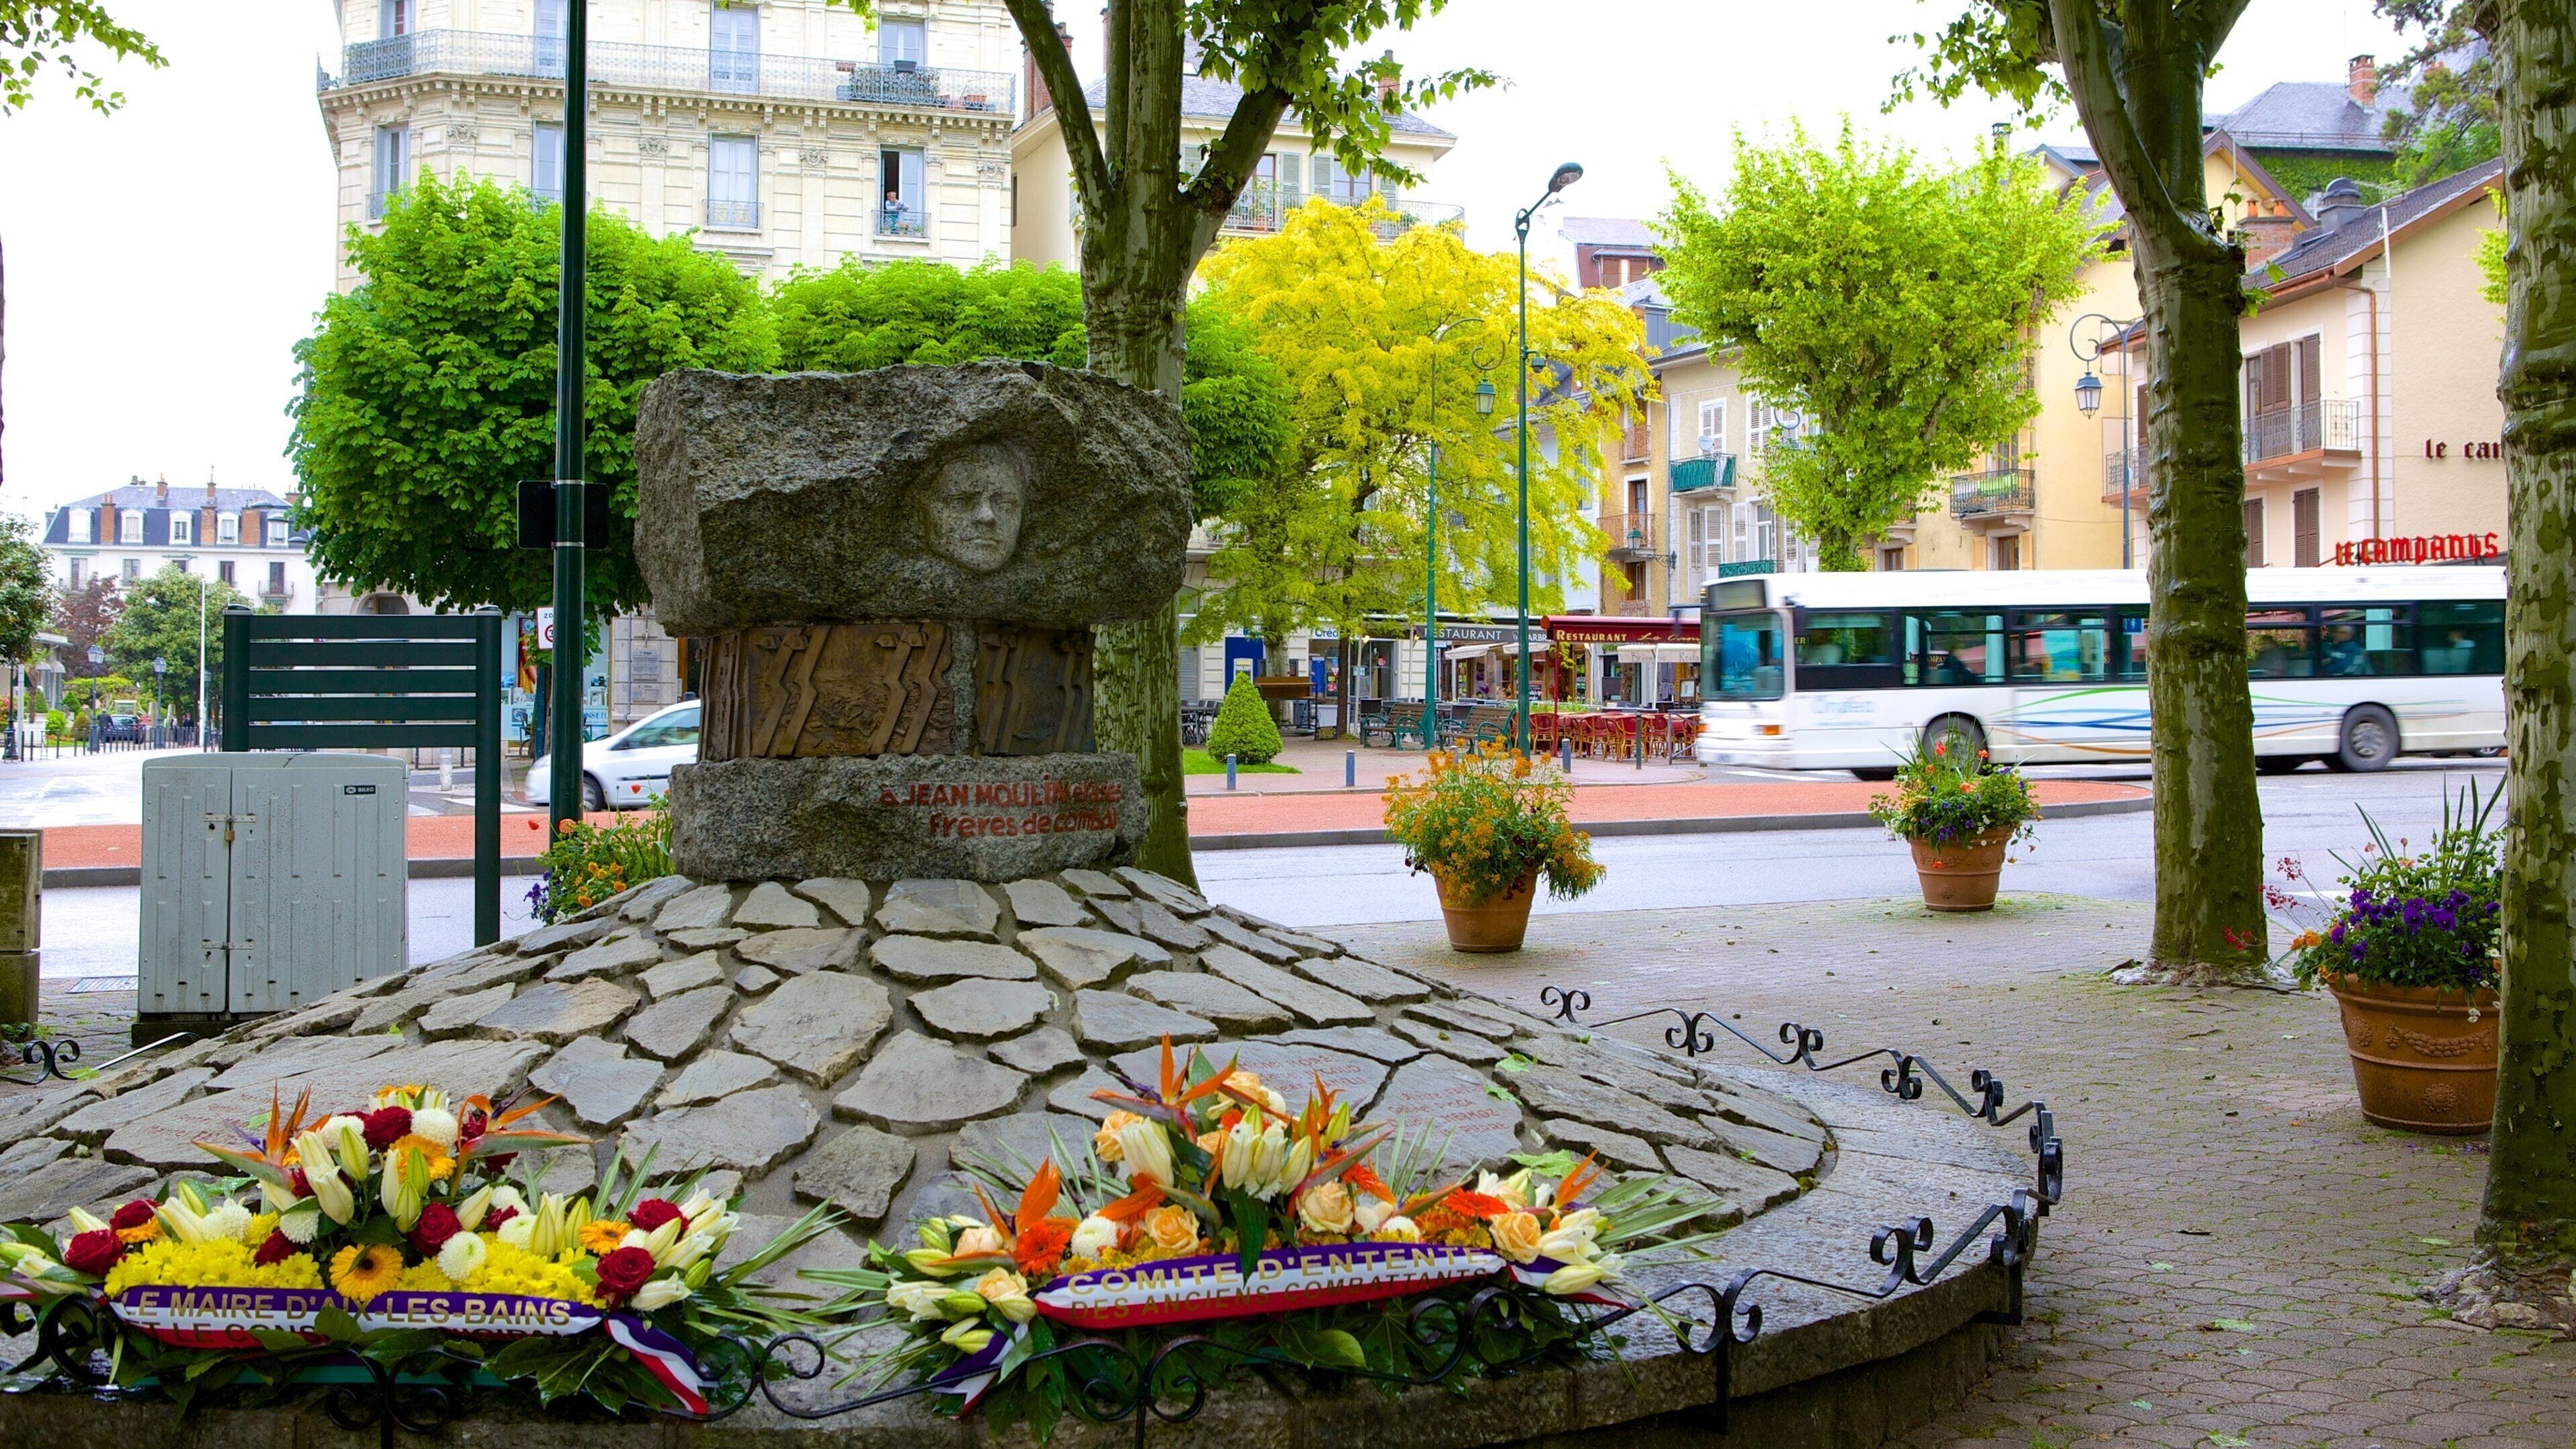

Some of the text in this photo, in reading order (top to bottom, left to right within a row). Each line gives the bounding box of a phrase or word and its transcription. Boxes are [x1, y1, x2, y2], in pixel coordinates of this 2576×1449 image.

[2425, 439, 2447, 459] le
[1424, 628, 1502, 640] ESTAURANT
[902, 783, 968, 806] JEAN
[1022, 812, 1051, 835] de
[1068, 1246, 1487, 1295] COMITE D'ENTENTE
[170, 1292, 274, 1320] MAIRE
[1071, 1297, 1129, 1320] DES
[1140, 1285, 1270, 1316] ANCIENS
